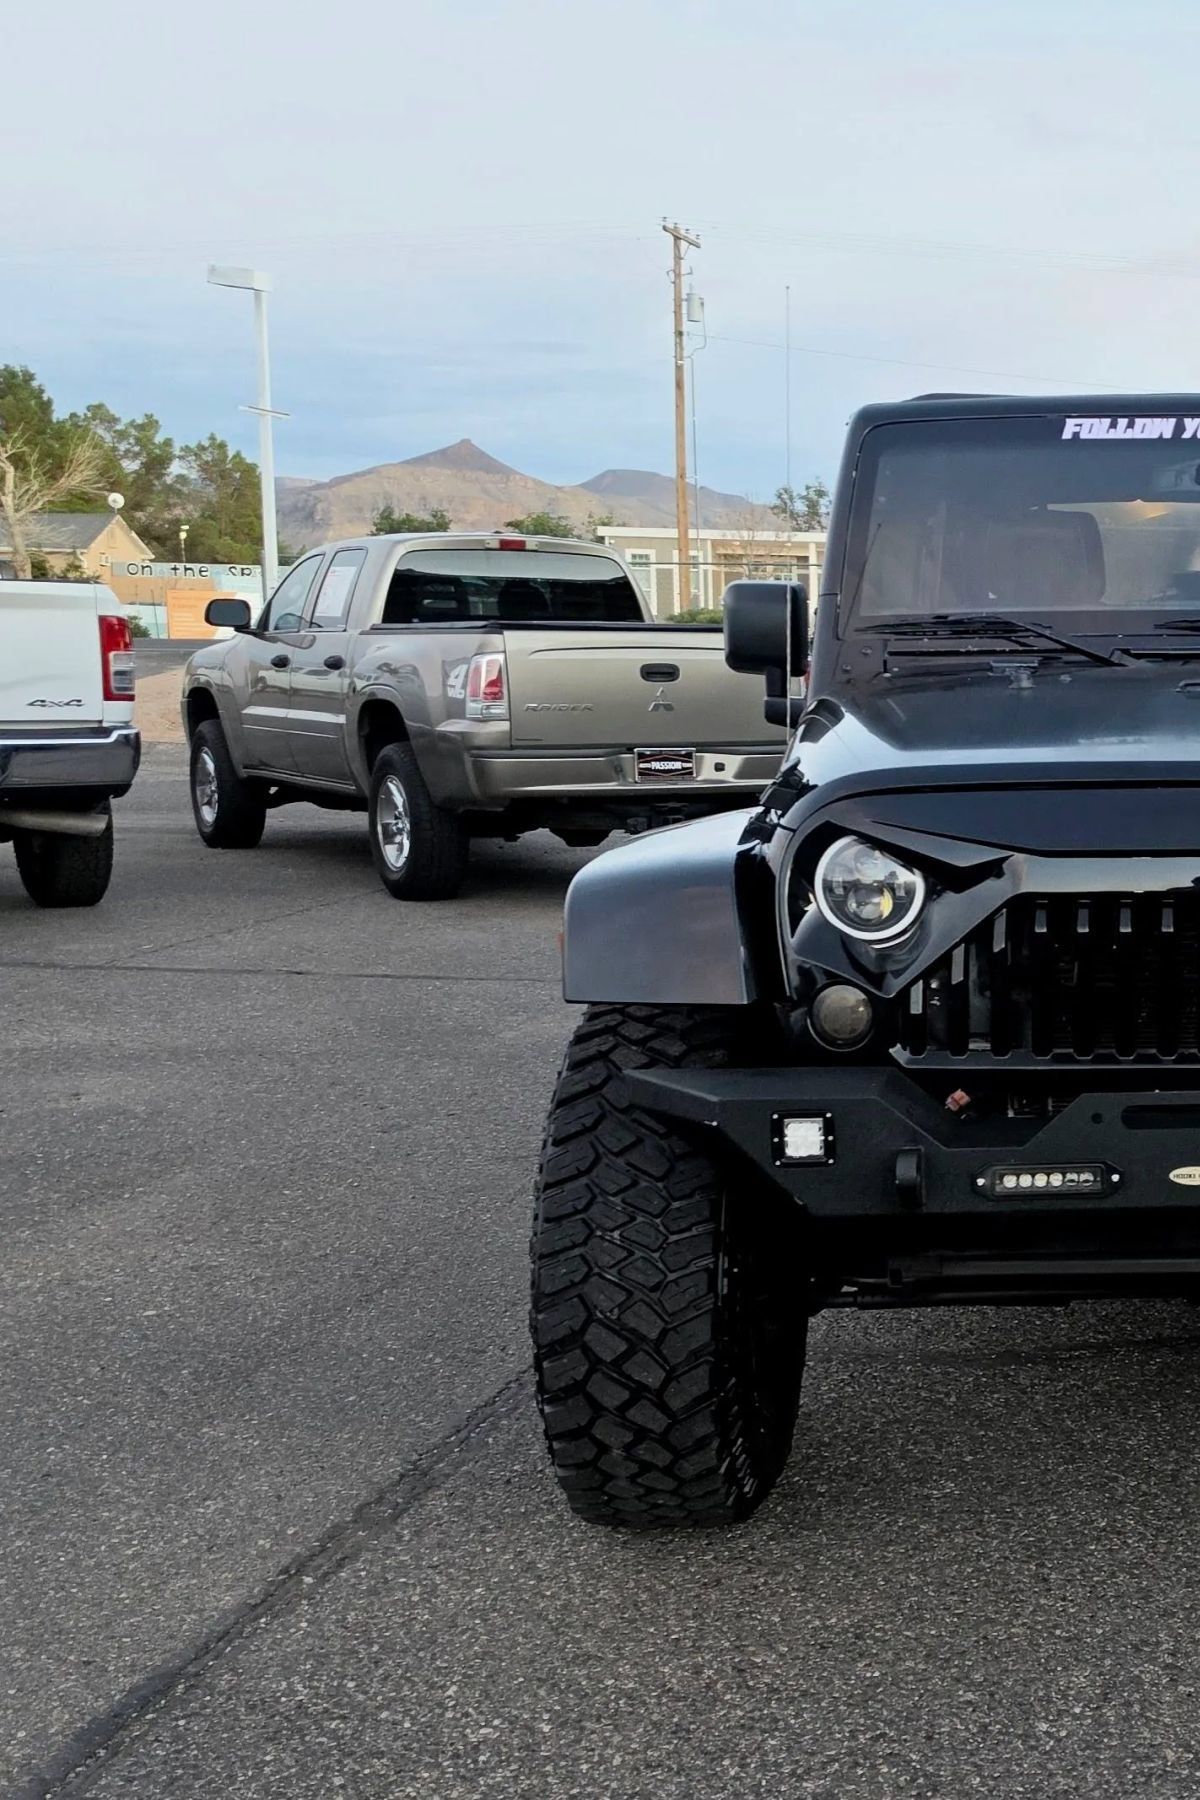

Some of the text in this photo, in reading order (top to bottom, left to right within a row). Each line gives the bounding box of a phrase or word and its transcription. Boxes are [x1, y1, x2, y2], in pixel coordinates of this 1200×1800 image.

[1061, 418, 1176, 439] FOLLOW
[170, 563, 209, 578] the
[523, 703, 595, 712] RAIDER
